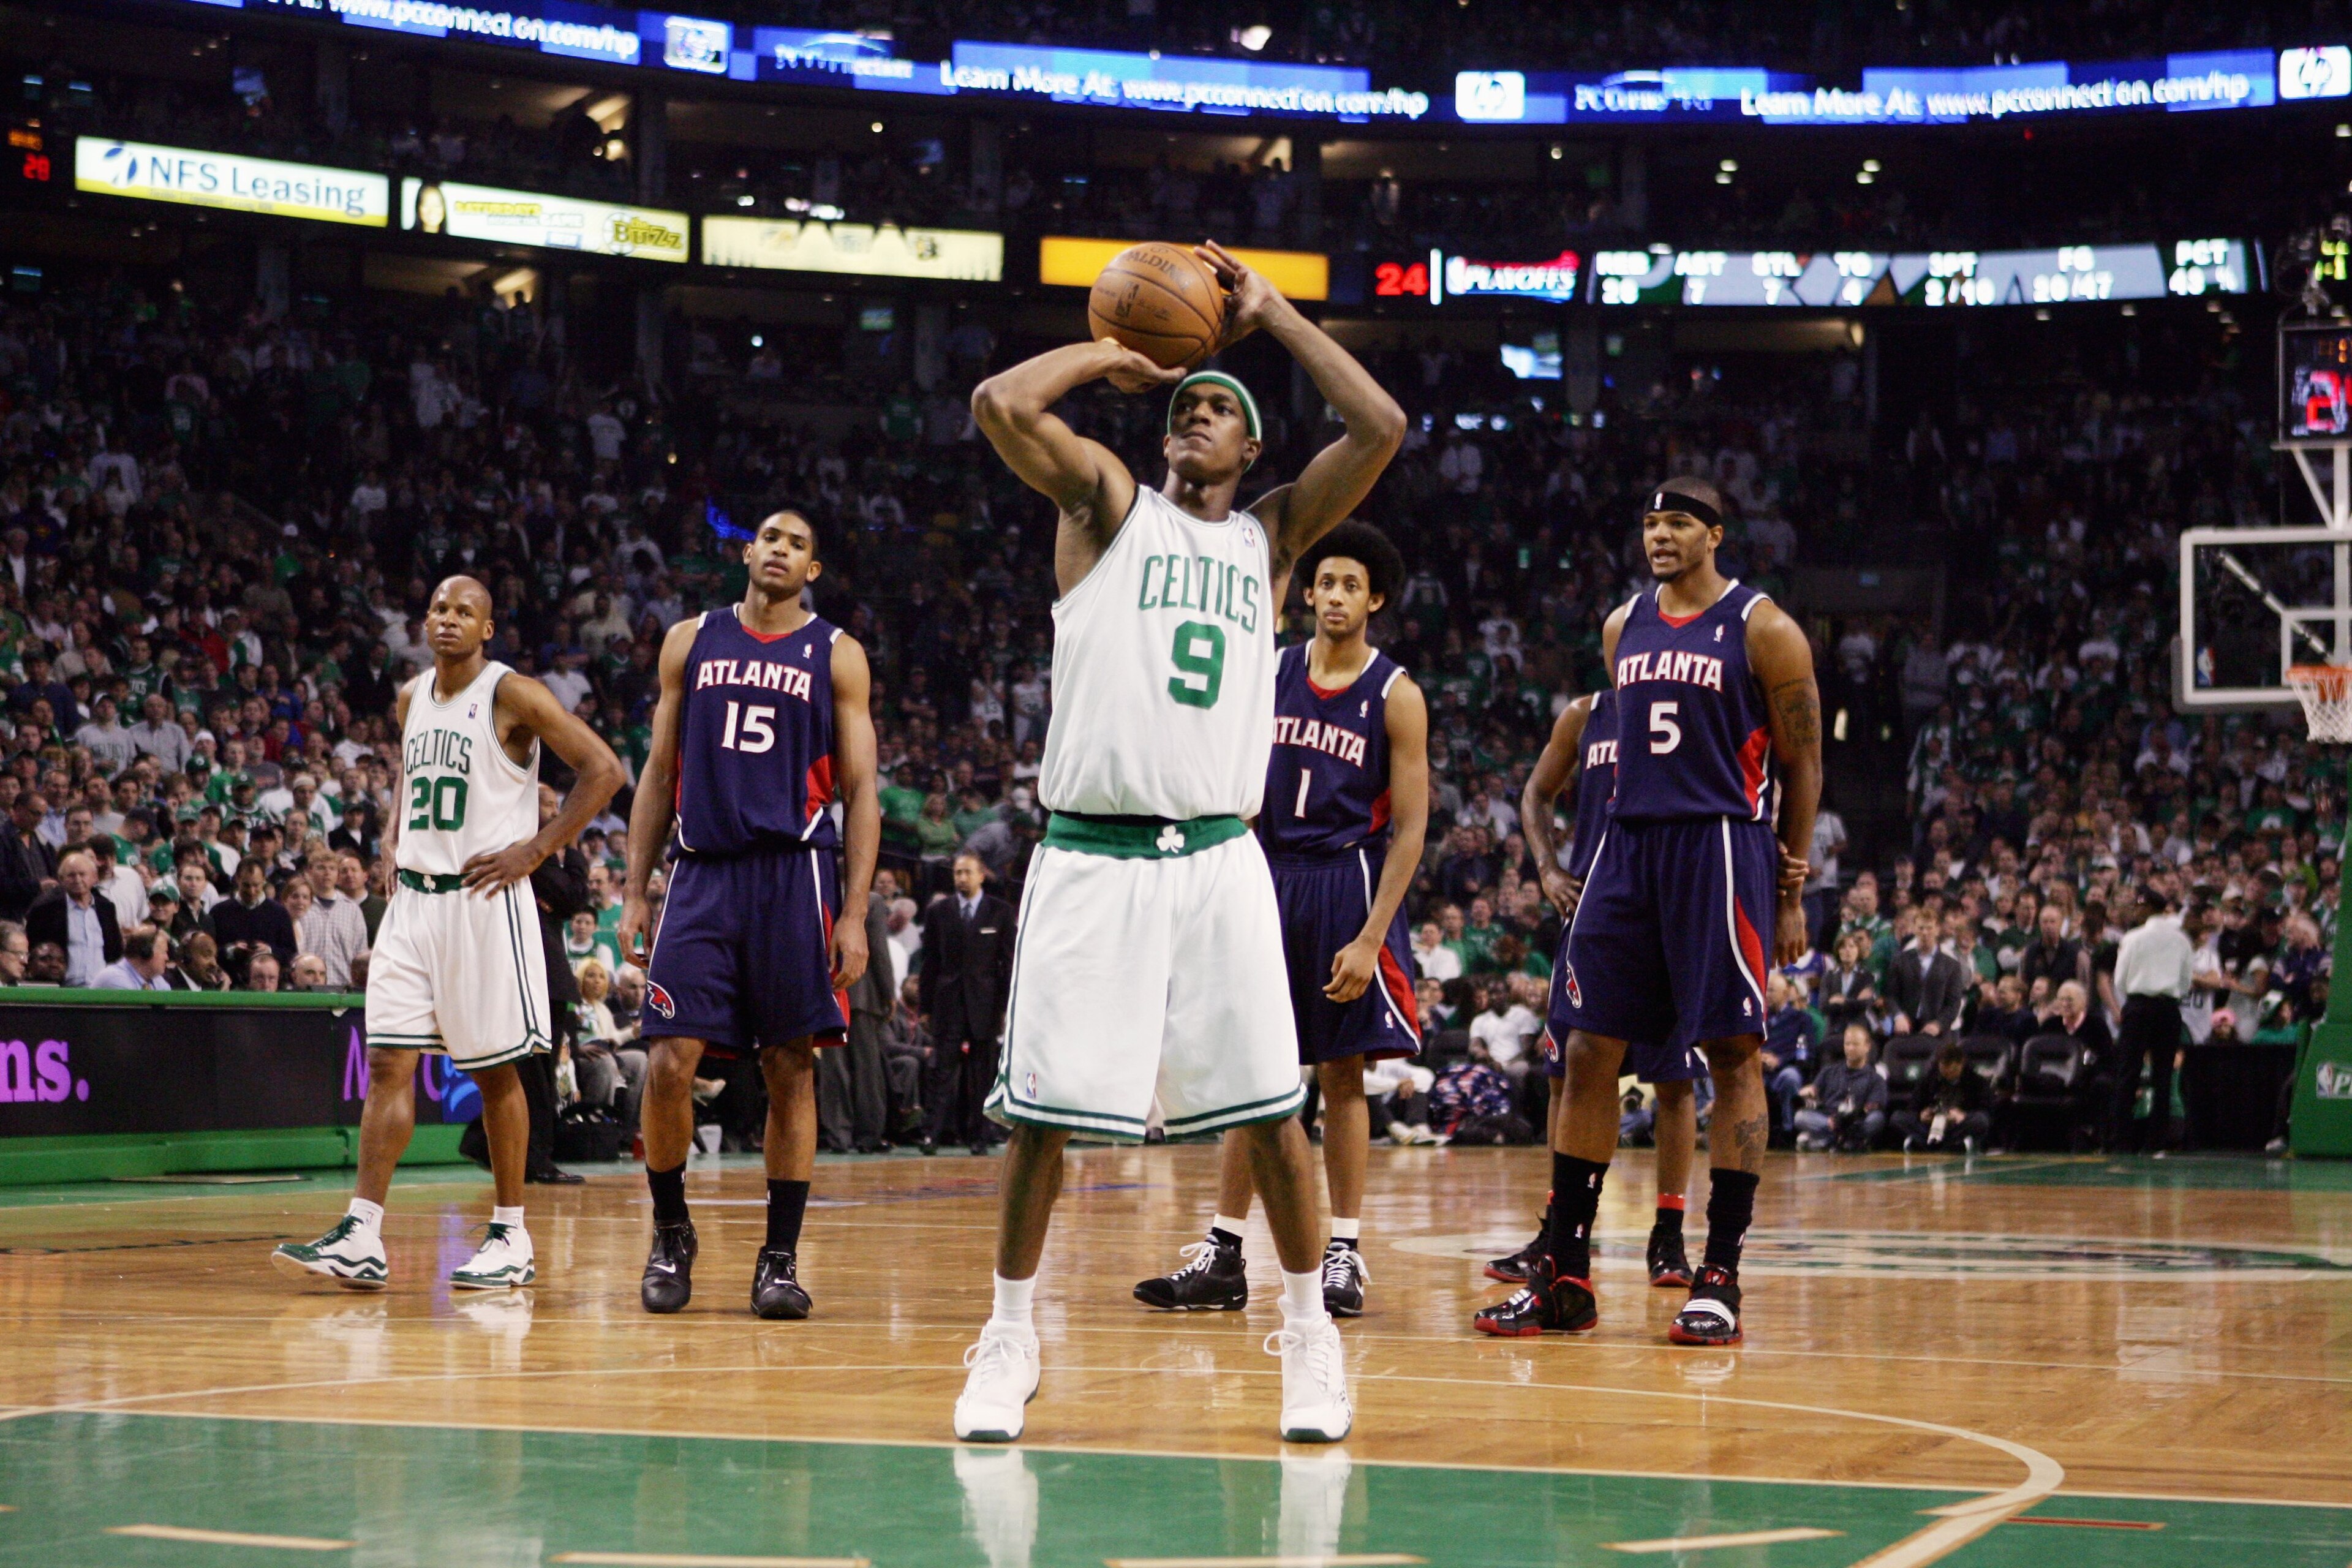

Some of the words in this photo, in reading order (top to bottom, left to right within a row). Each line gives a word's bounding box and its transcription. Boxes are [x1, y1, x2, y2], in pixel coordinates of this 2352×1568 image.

[329, 0, 639, 59] www.pcconnecton.com/hp
[940, 60, 1009, 91] Learn
[1012, 66, 1079, 95] More
[1741, 87, 1811, 115] Learn
[1814, 87, 1883, 115] More
[1927, 70, 2249, 119] www.pcconnecton.com/hp
[150, 156, 219, 193] NFS
[232, 167, 366, 219] Leasing
[1375, 262, 1430, 296] 24
[1596, 252, 1648, 275] REB
[1674, 252, 1727, 276] AST
[1752, 252, 1801, 277] STL
[1834, 252, 1873, 277] TO
[2176, 239, 2230, 266] PCT
[1687, 277, 1706, 304] 7
[1762, 277, 1782, 305] 7
[1841, 278, 1863, 306] 4
[1138, 554, 1259, 635] CELTICS
[695, 659, 813, 704] ATLANTA
[1167, 620, 1226, 710] 9
[1617, 650, 1725, 694] ATLANTA
[721, 699, 776, 754] 15
[1649, 701, 1682, 755] 5
[406, 728, 473, 776] CELTICS
[1586, 739, 1618, 770] ATL
[409, 775, 469, 832] 20
[1294, 767, 1312, 819] 1
[0, 1039, 90, 1103] ns.
